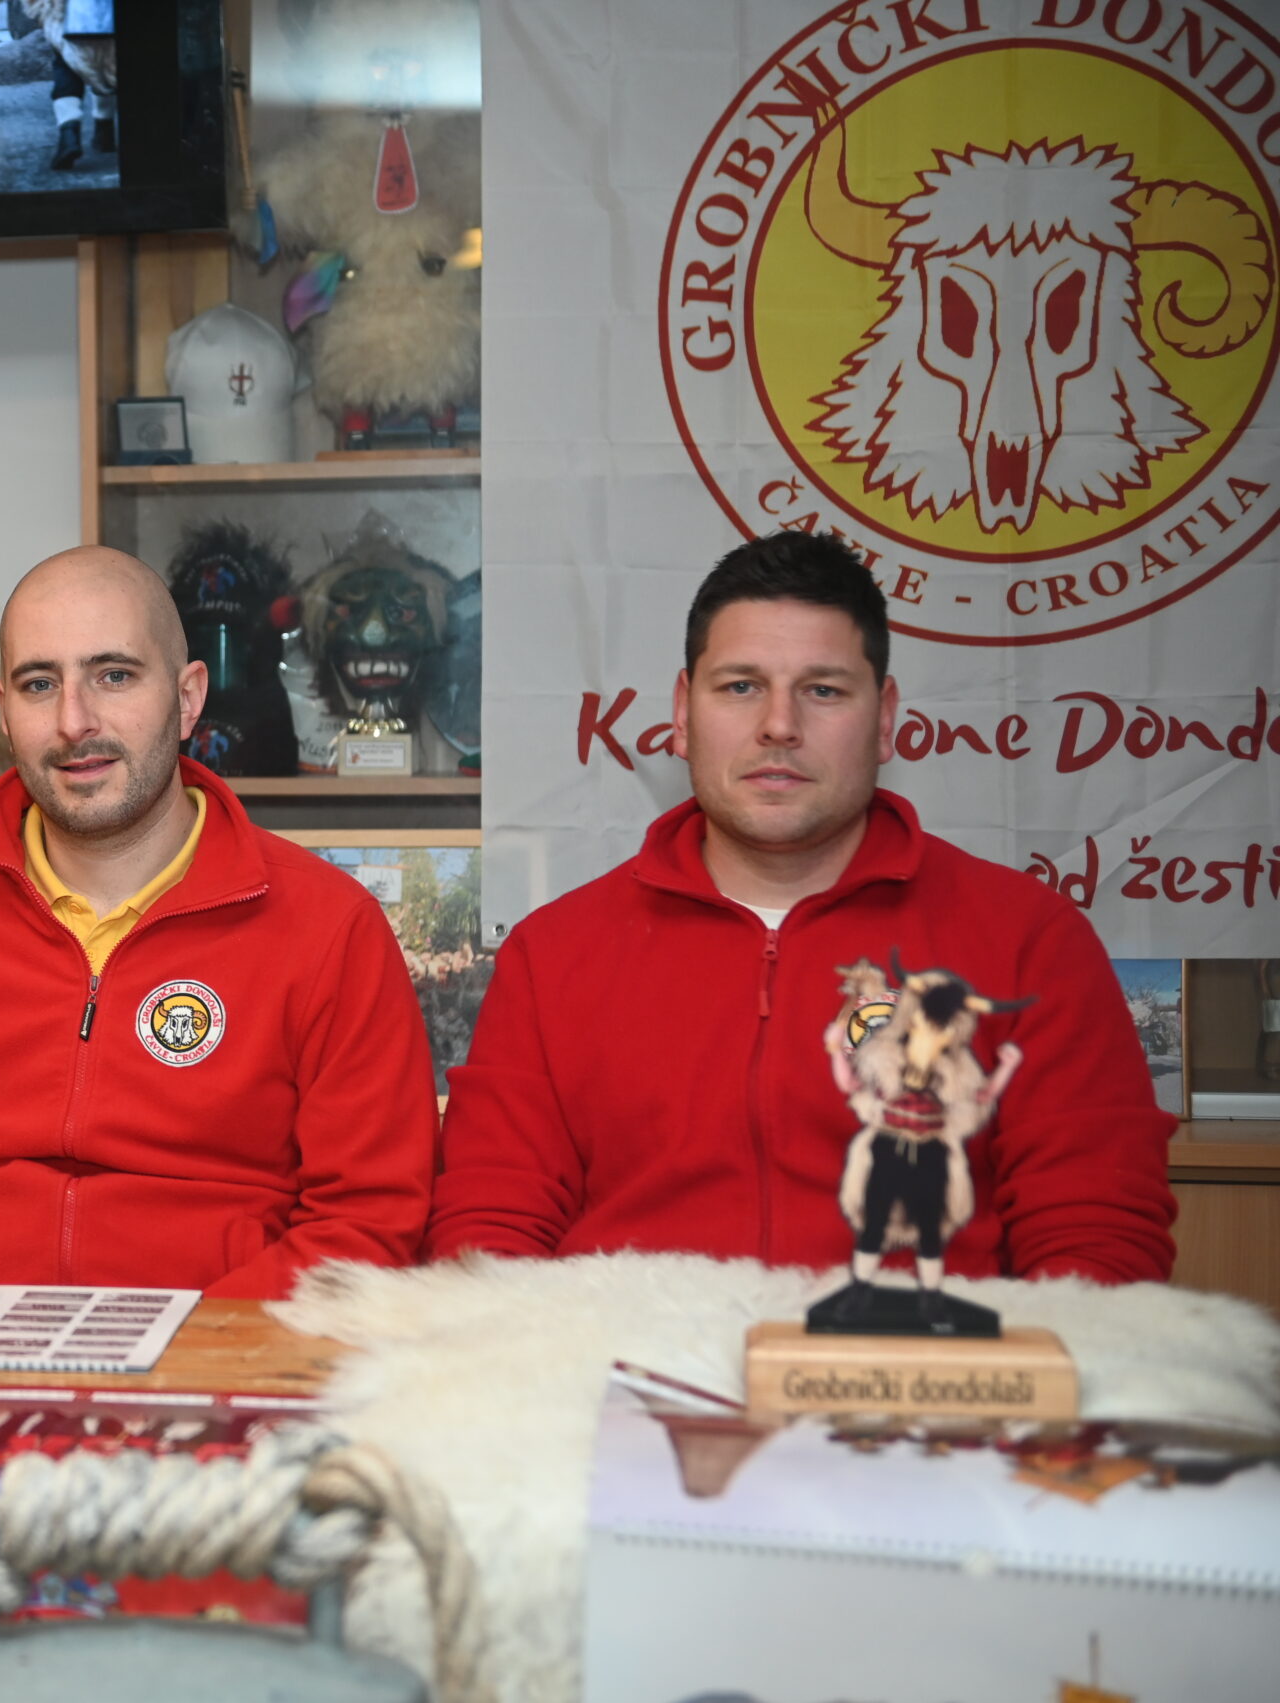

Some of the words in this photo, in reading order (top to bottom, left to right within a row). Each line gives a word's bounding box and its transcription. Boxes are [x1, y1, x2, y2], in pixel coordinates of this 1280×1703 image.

[682, 0, 989, 372] GROBNIČKI
[758, 475, 928, 604] ČAE
[1007, 474, 1270, 616] CROATIA
[142, 985, 180, 1024] GROBNIČKI
[186, 985, 221, 1027] DONDOLAŠI
[145, 1035, 171, 1059] ČAVLE
[175, 1040, 213, 1062] CROATIA
[783, 1368, 902, 1401] Grobnički
[910, 1369, 1035, 1403] dondolaši
